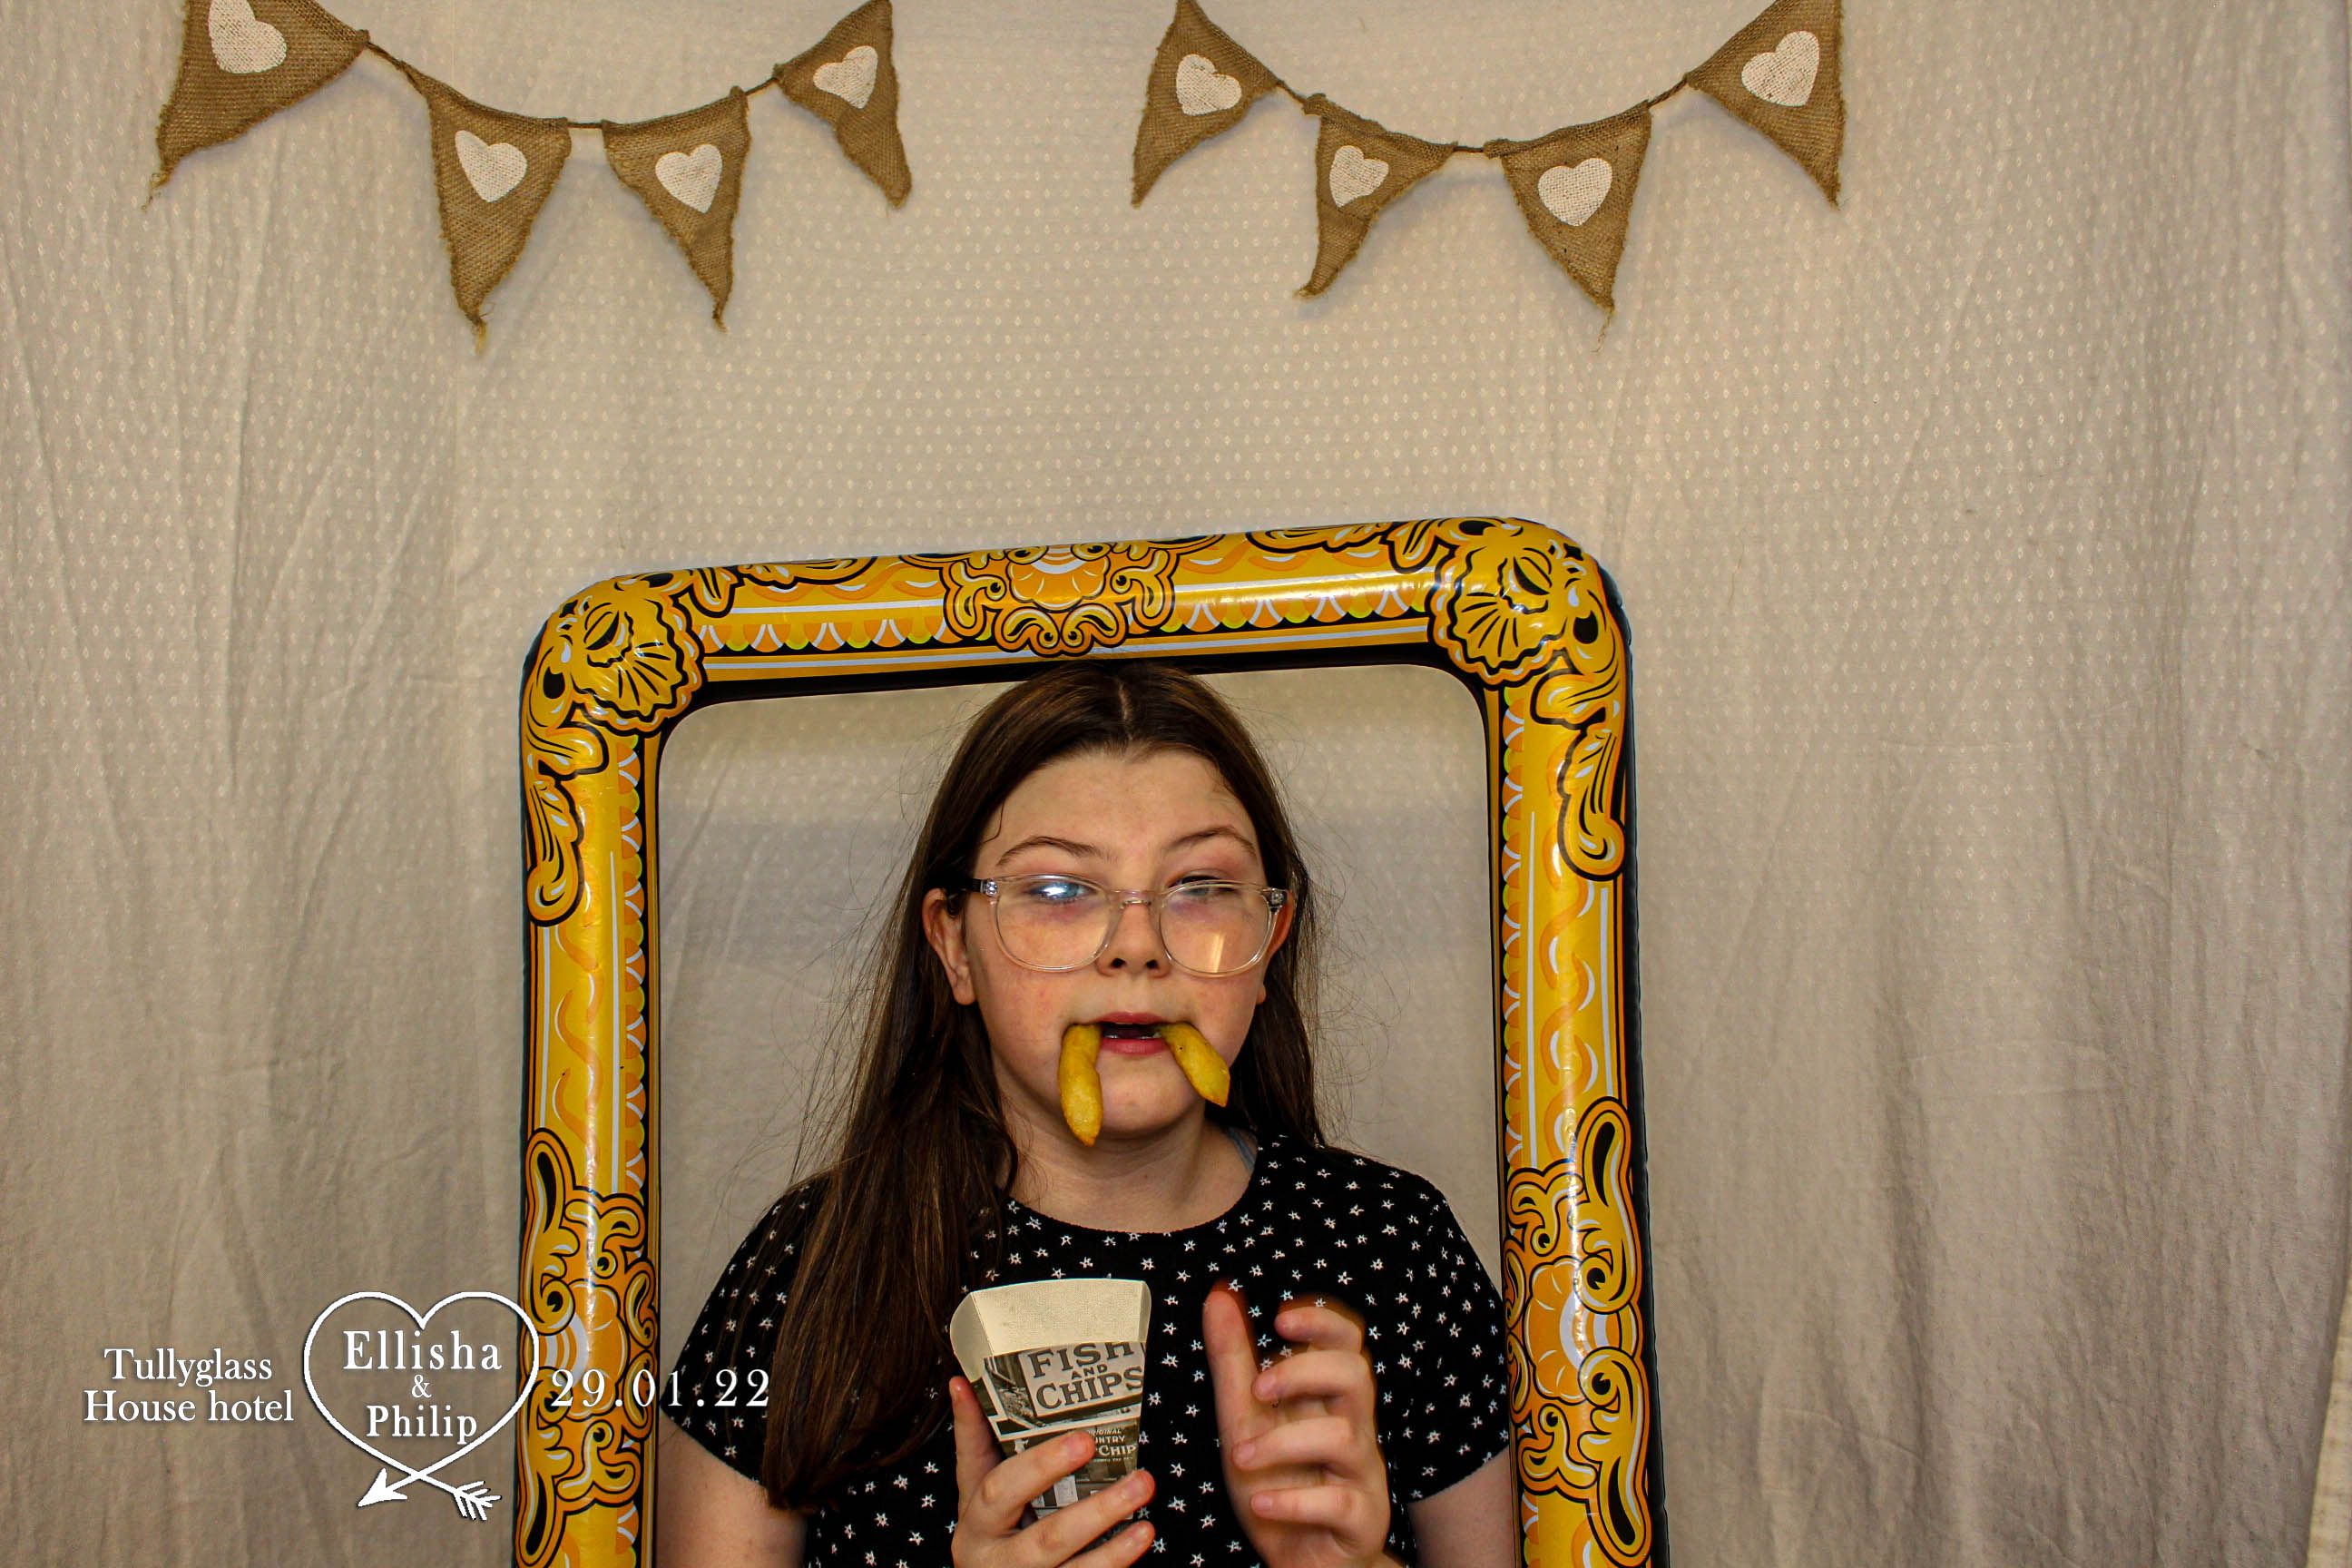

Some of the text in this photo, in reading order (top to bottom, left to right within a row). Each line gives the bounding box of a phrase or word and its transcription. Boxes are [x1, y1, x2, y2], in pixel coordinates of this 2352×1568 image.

[1027, 1342, 1134, 1378] FISH
[1071, 1364, 1108, 1380] AND
[1036, 1366, 1143, 1409] CHIPS
